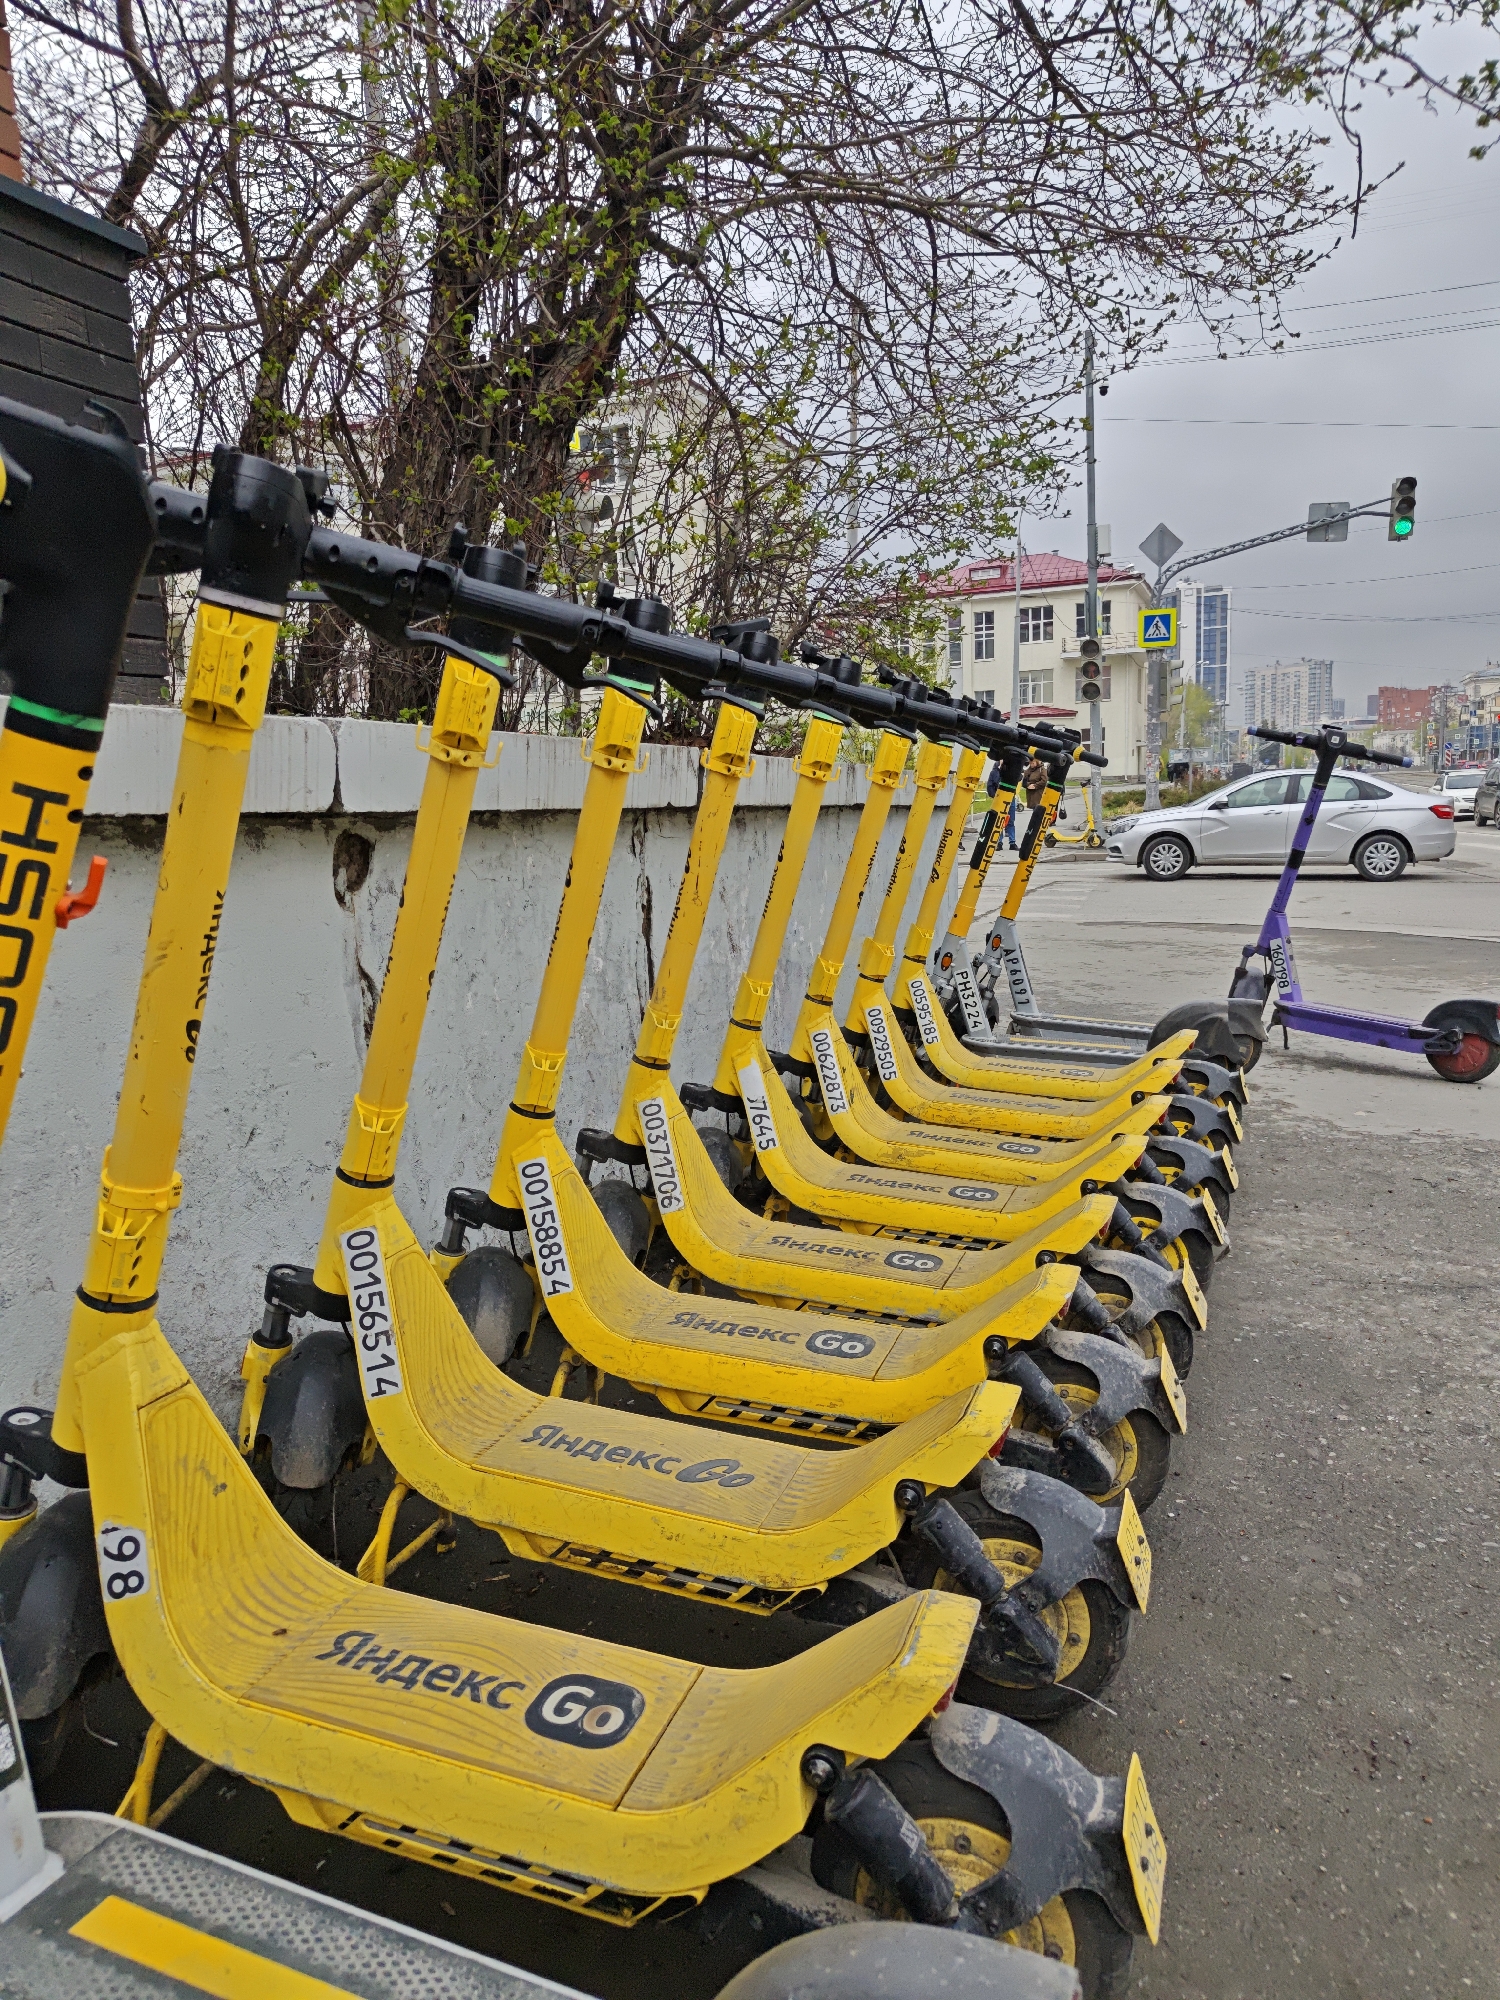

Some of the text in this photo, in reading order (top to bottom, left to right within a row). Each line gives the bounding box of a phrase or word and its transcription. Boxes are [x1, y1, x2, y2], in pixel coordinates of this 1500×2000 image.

[974, 801, 1012, 889] WHOOSH
[1021, 803, 1057, 883] WHOOSH
[1271, 943, 1290, 989] 160198
[867, 1008, 898, 1081] 00929505
[910, 980, 939, 1045] 00595185
[812, 1032, 847, 1113] 00622873
[642, 1102, 682, 1210] 00371706
[906, 1130, 994, 1148] Яндекс
[845, 1173, 944, 1194] Яндекс
[521, 1161, 571, 1297] 00158854
[766, 1235, 880, 1263] Яндекс
[346, 1229, 400, 1399] 00156514
[666, 1311, 802, 1346] Яндекс
[520, 1423, 756, 1488] Яндекс Go
[314, 1629, 625, 1736] Яндекс Go
